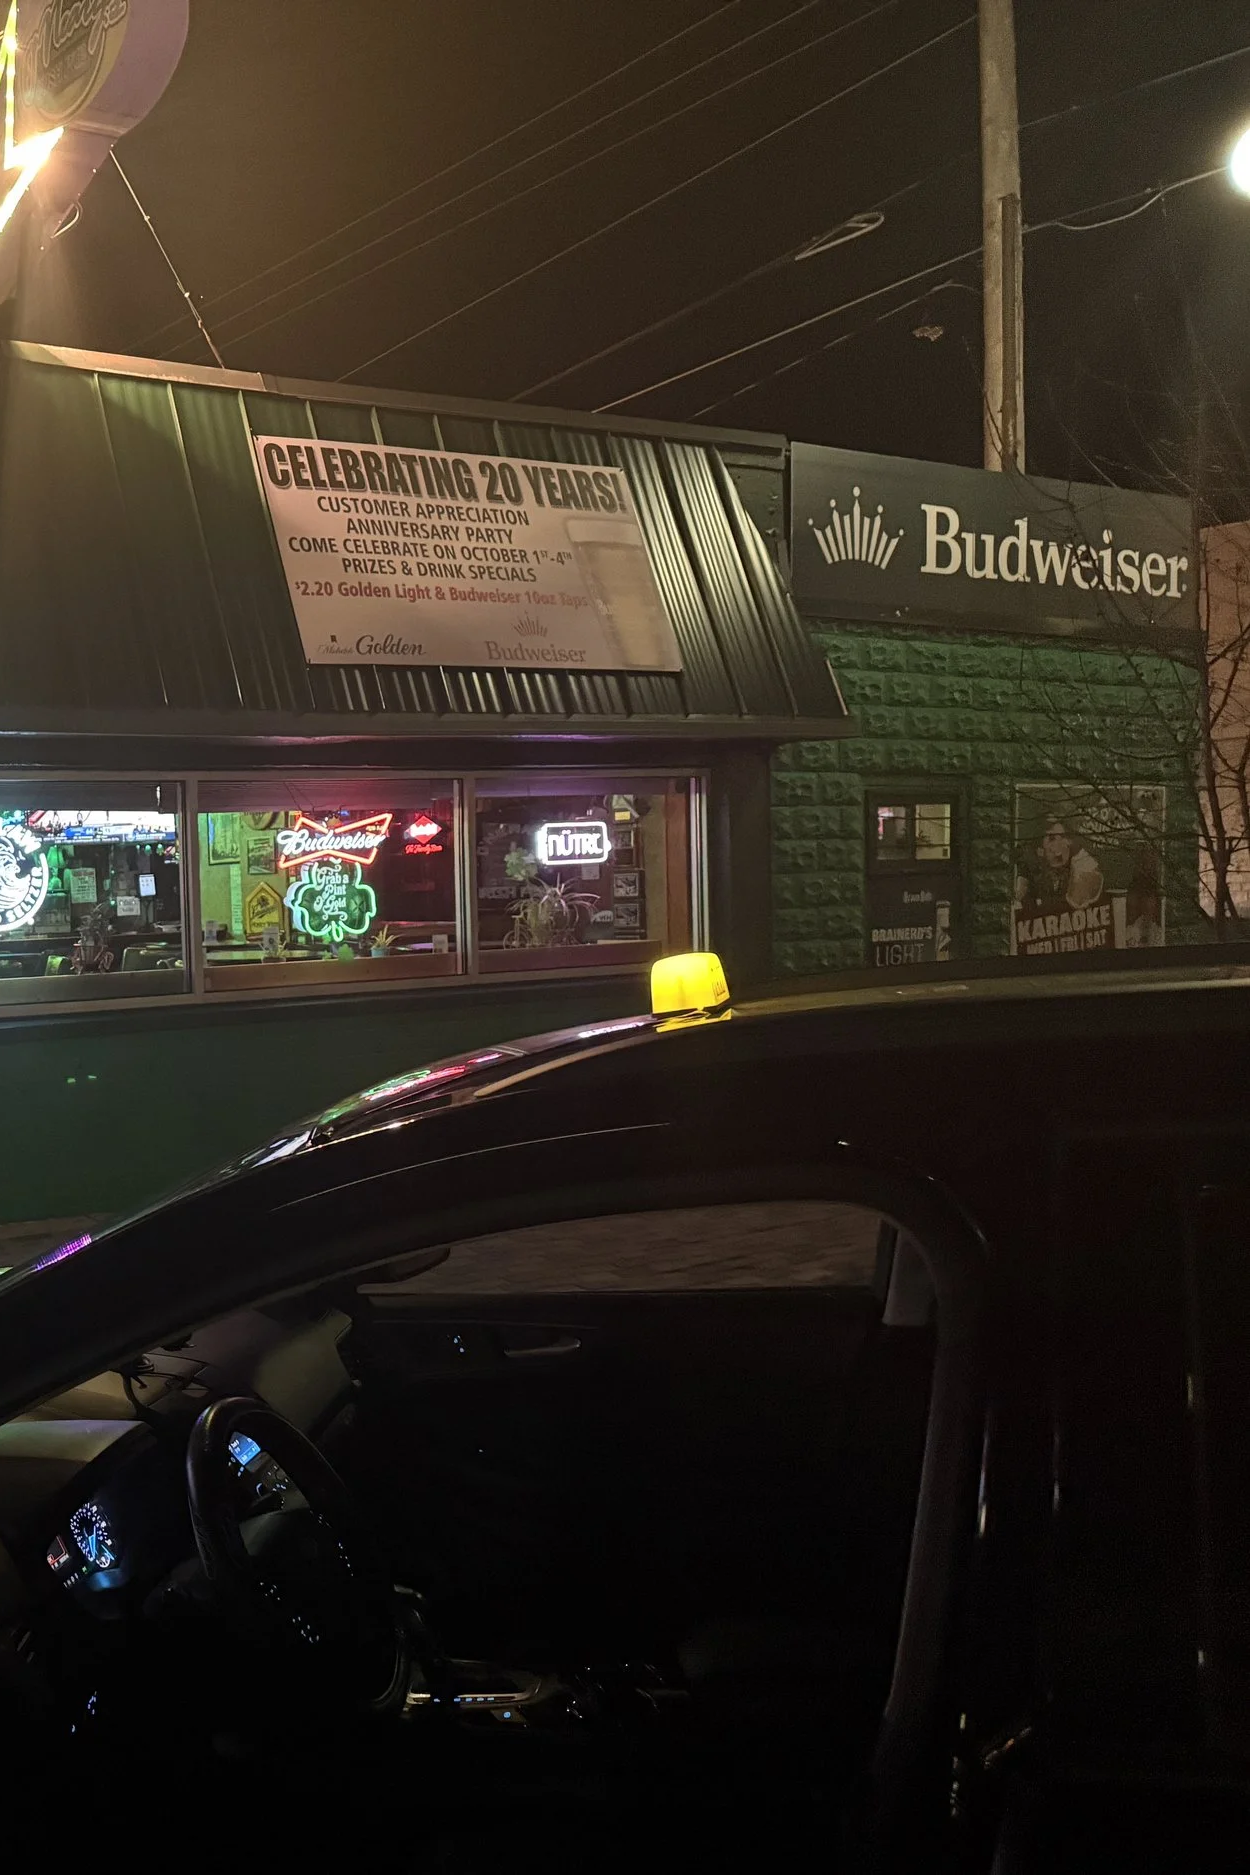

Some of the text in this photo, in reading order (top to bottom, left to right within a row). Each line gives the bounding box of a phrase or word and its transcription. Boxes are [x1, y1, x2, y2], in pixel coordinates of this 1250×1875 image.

[262, 443, 629, 514] CELEBRATING 20 YEARS!
[317, 496, 530, 526] CUSTOMER APPRECIATION
[346, 518, 513, 545] ANNIVERSARY PARTY
[288, 536, 338, 553] COME
[343, 538, 430, 558] CELEBRATE
[433, 545, 457, 560] ON
[461, 547, 528, 564] OCTOBER
[920, 503, 1188, 599] Budweiser
[341, 558, 537, 582] PRIZES & DRINK SPECIALS
[295, 581, 333, 597] $2.20
[338, 581, 391, 598] Golden
[395, 583, 431, 602] Light
[434, 586, 446, 600] &
[450, 586, 520, 604] Budweiser
[355, 634, 426, 655] Golden
[484, 640, 586, 663] Budweiser
[276, 828, 386, 856] Budweiser
[315, 865, 349, 891] Grab a
[322, 884, 347, 900] Pint
[323, 895, 347, 914] Gold
[1017, 904, 1111, 943] KARAOKE
[1086, 929, 1107, 946] SAT
[876, 943, 924, 967] LIGHT
